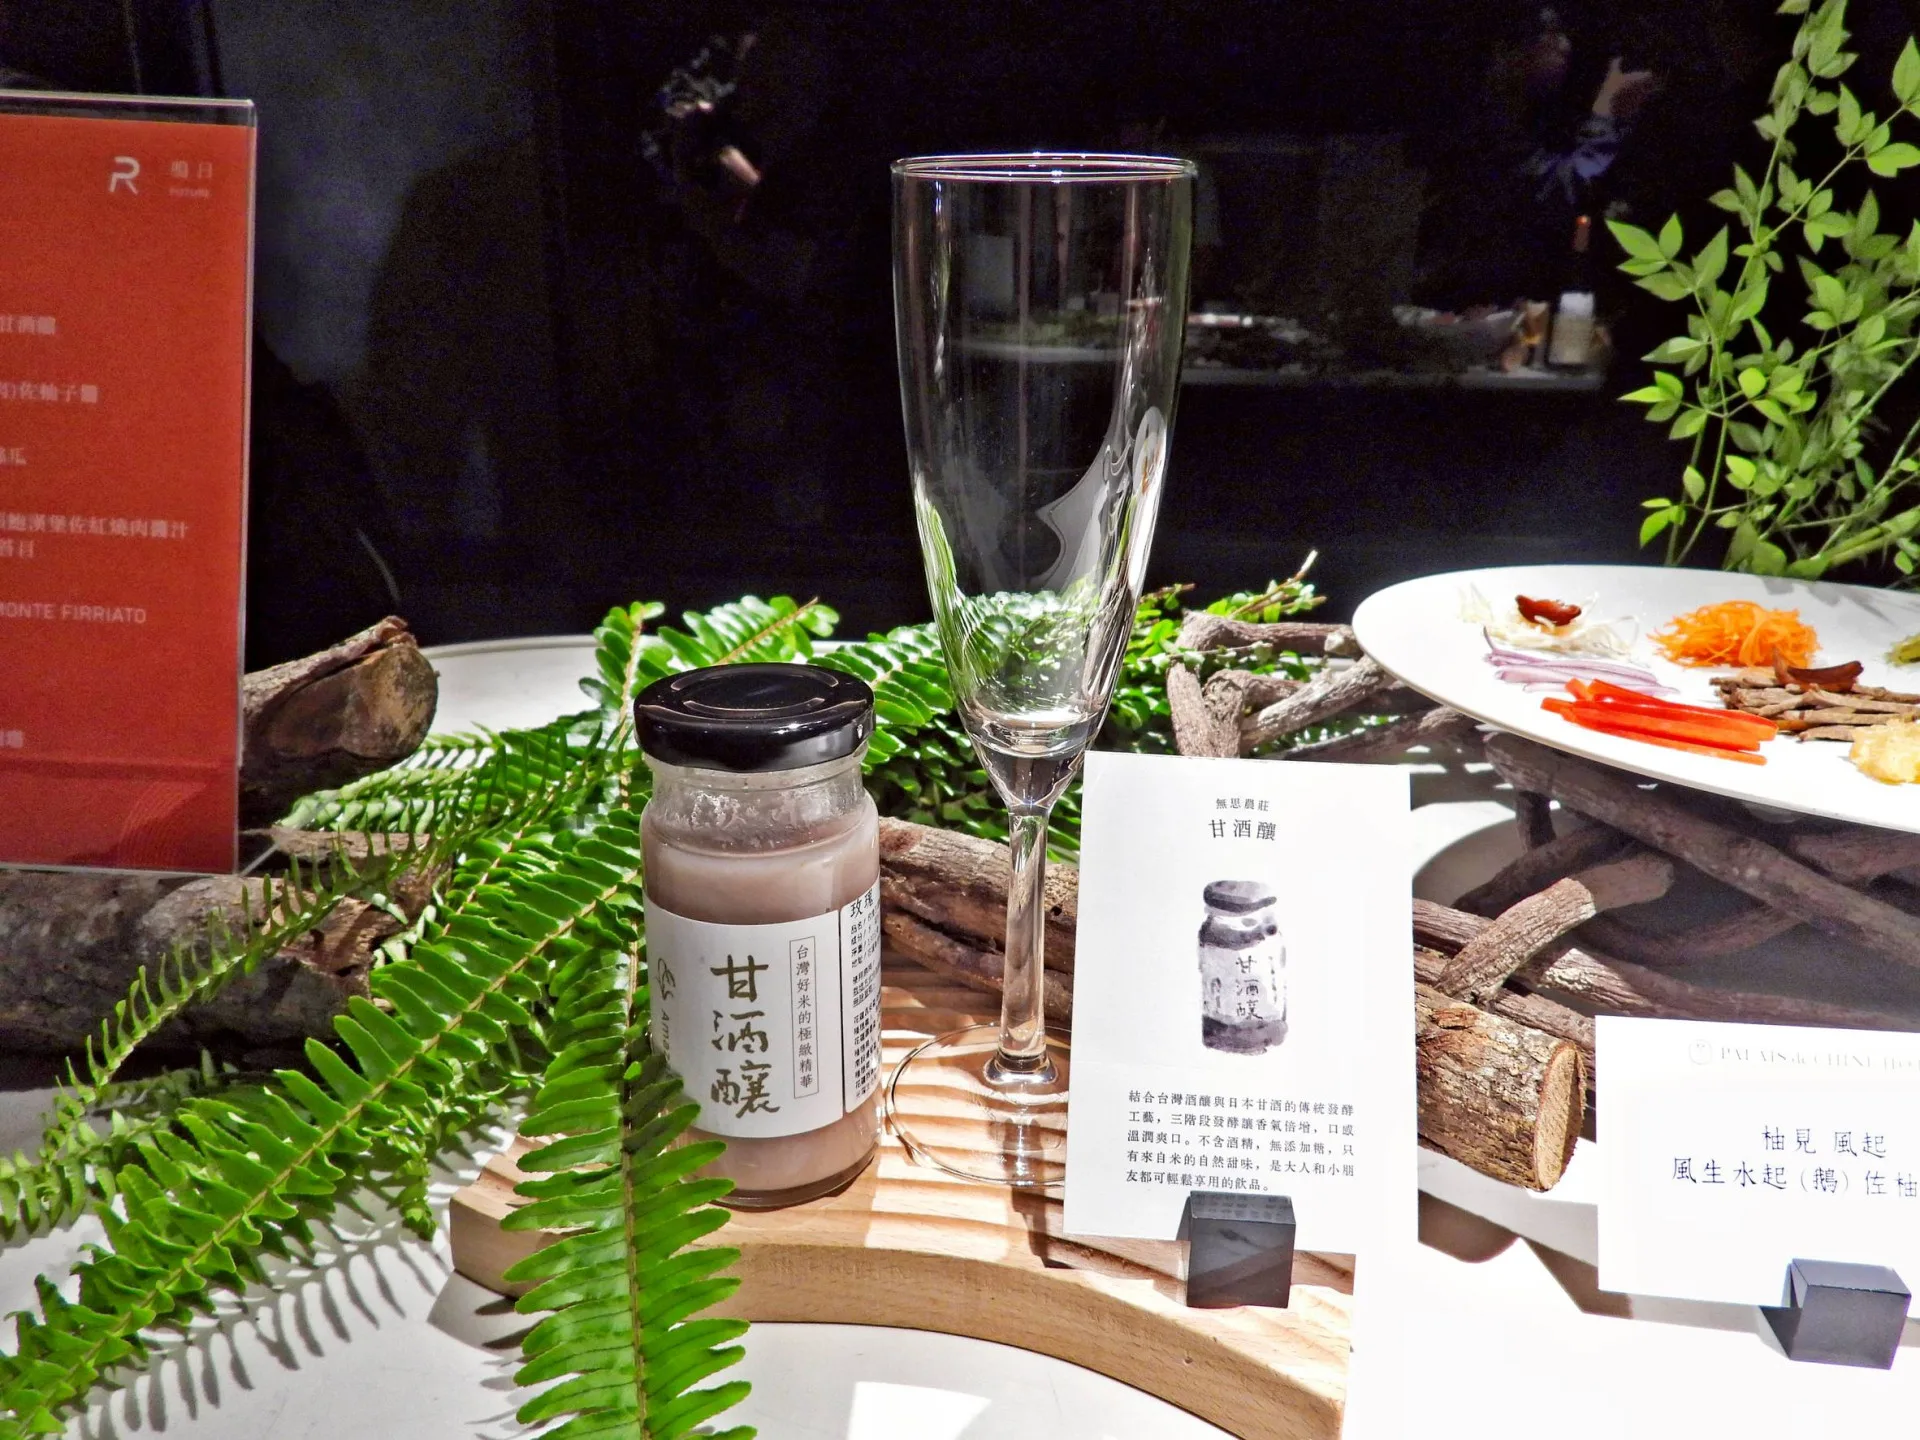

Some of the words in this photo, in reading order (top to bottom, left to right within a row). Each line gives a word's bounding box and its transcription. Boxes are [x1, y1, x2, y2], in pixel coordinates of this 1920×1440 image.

[61, 604, 147, 624] FIRRIATO
[1208, 818, 1276, 841] 甘酒釀
[710, 954, 780, 1119] 甘酒釀
[1128, 1089, 1354, 1117] 結合台灣酒釀與日本甘酒的傳統發酵
[1762, 1125, 1816, 1154] 柚見
[1834, 1131, 1887, 1159] 風起
